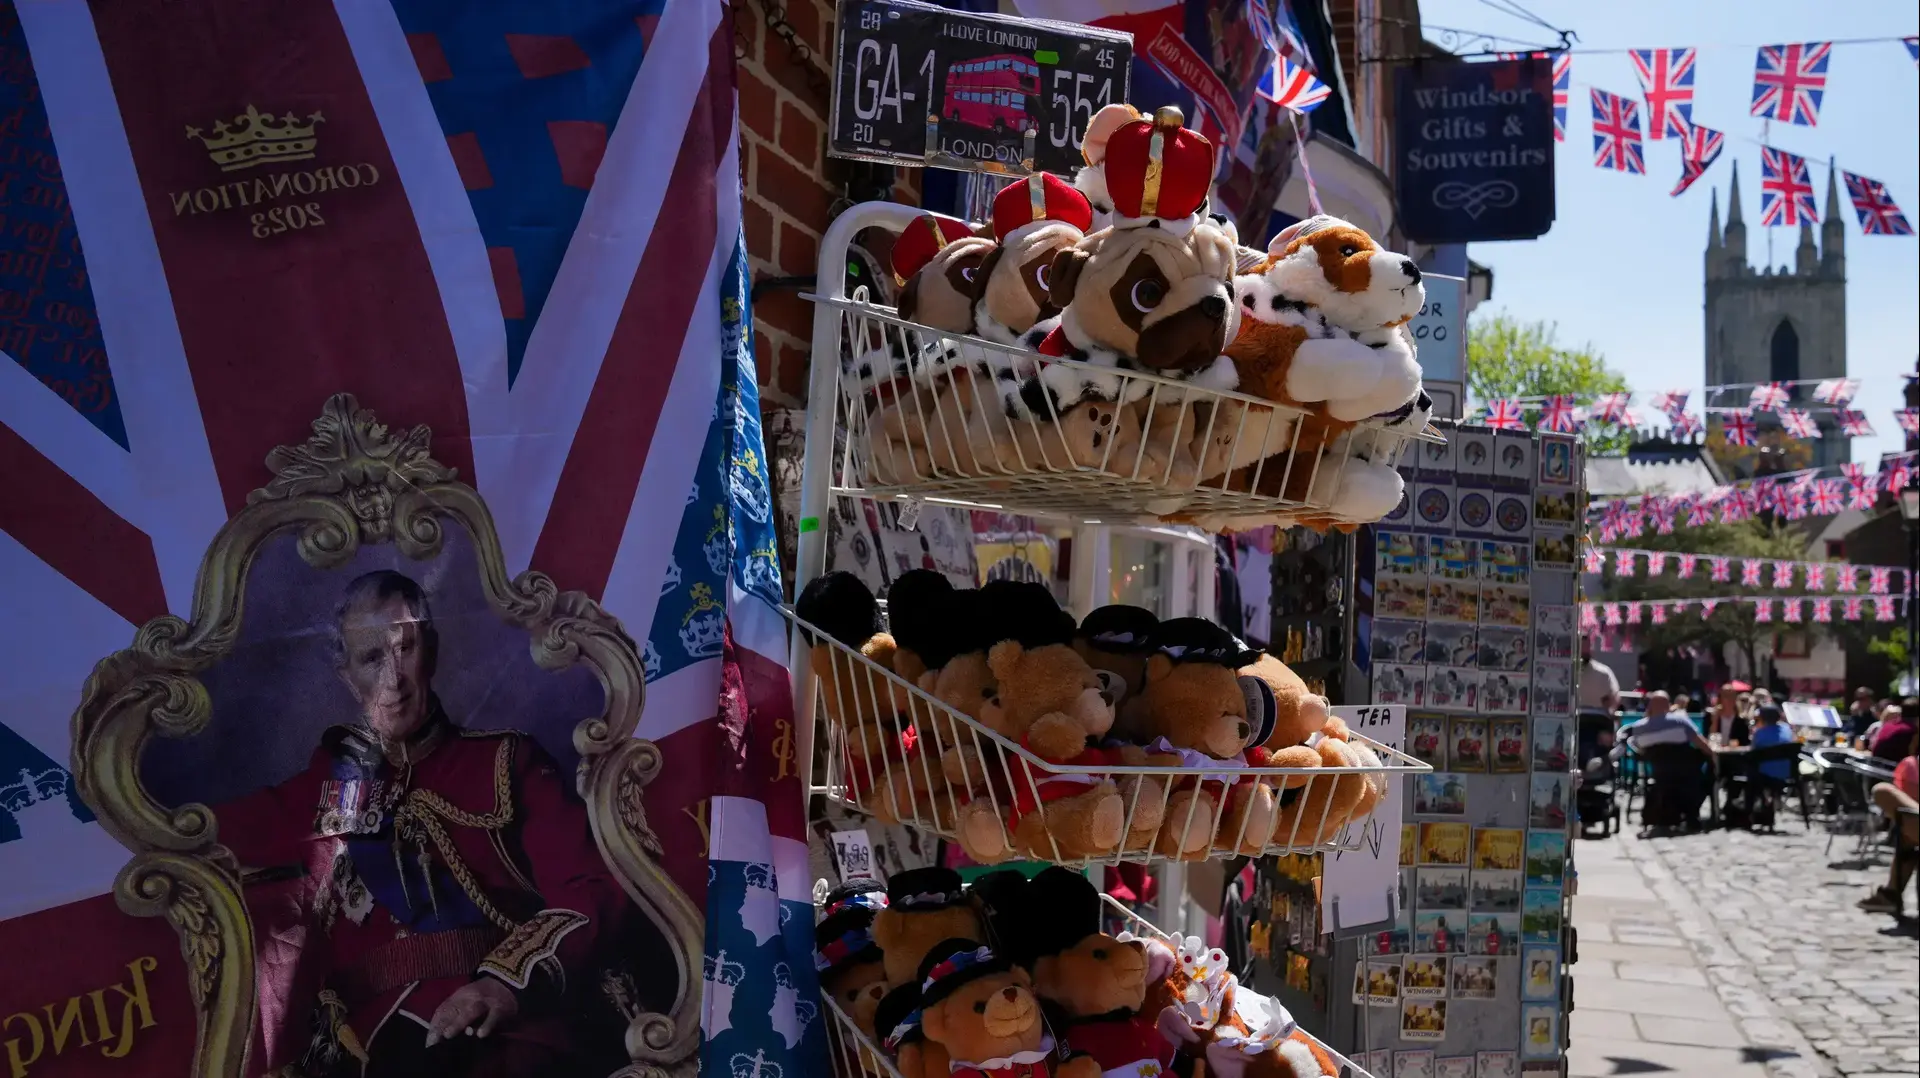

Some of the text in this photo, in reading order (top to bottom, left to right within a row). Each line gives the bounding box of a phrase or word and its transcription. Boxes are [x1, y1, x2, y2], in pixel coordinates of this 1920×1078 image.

[860, 10, 881, 31] 28
[943, 23, 1038, 51] I LOVE LONDON
[1095, 49, 1115, 69] 45
[854, 38, 936, 124] GA-1
[1412, 84, 1533, 110] Windsor
[853, 123, 873, 144] 20
[1421, 113, 1524, 141] Gifts &
[941, 137, 1023, 164] LONDON
[1407, 144, 1546, 172] Souvenirs
[1357, 707, 1392, 728] TEA
